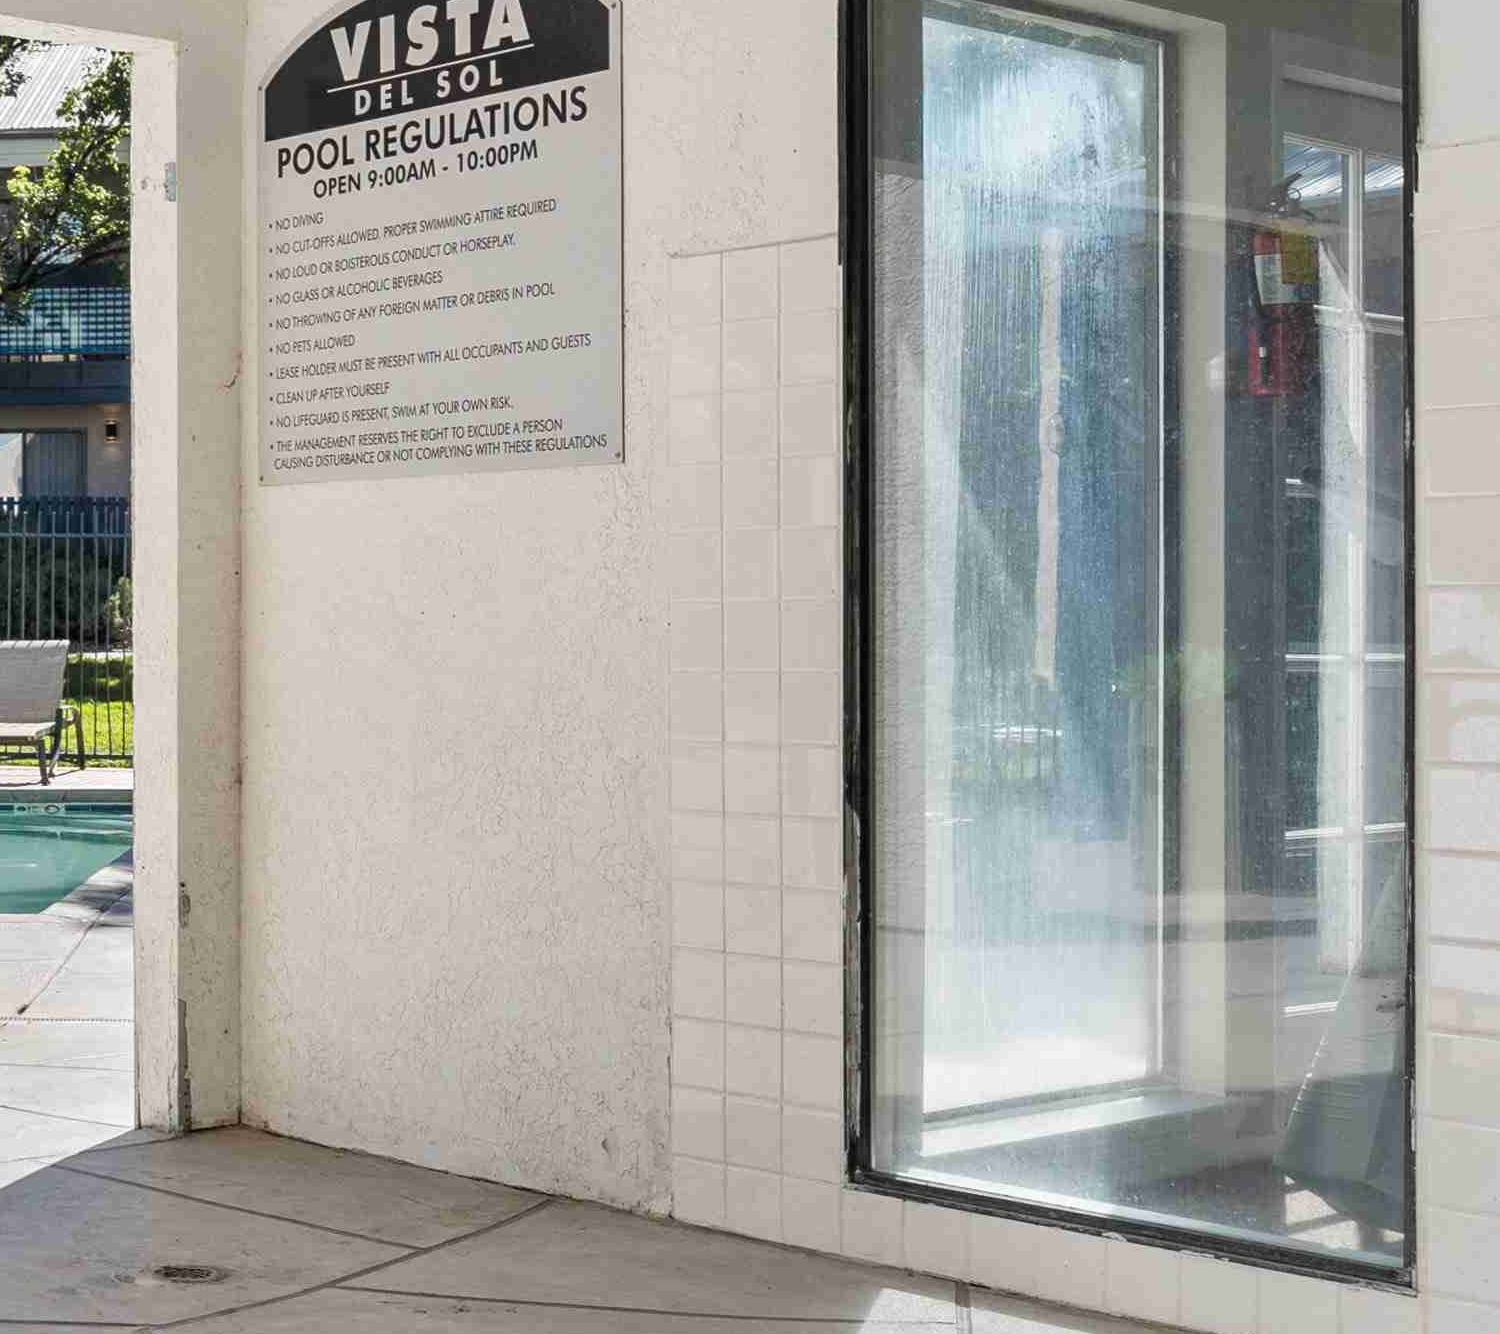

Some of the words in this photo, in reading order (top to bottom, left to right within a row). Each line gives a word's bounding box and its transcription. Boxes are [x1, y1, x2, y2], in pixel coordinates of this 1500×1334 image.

[354, 83, 414, 115] DEL
[436, 60, 503, 98] SOL
[277, 136, 354, 178] POOL
[365, 85, 588, 162] REGULATIONS
[313, 172, 361, 198] OPEN
[368, 158, 437, 189] 9:00AM
[457, 139, 539, 172] 10:00PM
[276, 217, 290, 231] NO
[292, 212, 324, 228] DIVING
[276, 243, 290, 255] NO
[292, 235, 335, 253] CUT-OFFS
[383, 222, 417, 238] PROPER
[419, 212, 472, 233] SWIMMING
[473, 207, 504, 223] ATTIRE
[506, 198, 557, 218] REQUIRED
[276, 268, 290, 280] NO
[292, 264, 317, 278] LOUD
[320, 262, 333, 274] OR
[335, 254, 390, 272] BOISTEROUS
[392, 244, 441, 263] CONDUCT
[443, 242, 458, 256] OR
[276, 292, 290, 305] NO
[292, 288, 319, 302] GLASS
[321, 286, 335, 299] OR
[336, 278, 390, 297] ALCOHOLIC
[392, 270, 443, 290] BEVERAGES
[276, 317, 290, 330] NO
[292, 310, 341, 328] THROWING
[343, 309, 356, 322] OF
[358, 306, 377, 320] ANY
[379, 301, 420, 317] FOREIGN
[423, 295, 458, 311] MATTER
[460, 293, 475, 307] OR
[477, 287, 510, 305] DEBRIS
[512, 285, 524, 299] IN
[526, 283, 556, 298] POOL
[276, 342, 290, 355] NO
[292, 339, 311, 353] PETS
[313, 334, 355, 351] ALLOWED
[276, 366, 299, 379] LEASE
[302, 362, 337, 377] HOLDER
[338, 359, 363, 373] MUST
[365, 357, 377, 370] BE
[378, 353, 416, 369] PRESENT
[417, 351, 441, 365] WITH
[443, 348, 460, 361] ALL
[462, 341, 524, 360] OCCUPANTS
[525, 338, 548, 352] AND
[551, 333, 592, 350] GUESTS
[276, 391, 303, 404] CLEAN
[305, 389, 318, 402] UP
[319, 386, 346, 400] AFTER
[347, 382, 390, 398] YOURSELF
[276, 415, 290, 428] NO
[293, 411, 340, 427] LIFEGUARD
[342, 410, 350, 423] IS
[392, 404, 417, 418] SWIM
[419, 403, 431, 416] AT
[432, 401, 459, 415] YOUR
[461, 398, 488, 412] OWN
[274, 456, 314, 470] CAUSING
[316, 450, 375, 467] DISTURBANCE
[377, 450, 391, 463] OR
[393, 448, 414, 461] NOT
[416, 444, 473, 460] COMPLYING
[475, 442, 500, 455] WITH
[503, 440, 533, 453] THESE
[535, 434, 608, 452] REGULATIONS
[276, 440, 292, 452] THE
[294, 435, 356, 451] MANAGEMENT
[358, 431, 399, 446] RESERVES
[401, 429, 419, 442] THE
[421, 427, 449, 441] RIGHT
[452, 426, 464, 439] TO
[467, 422, 511, 438] EXCLUDE
[513, 422, 521, 435] A
[522, 419, 563, 434] PERSON
